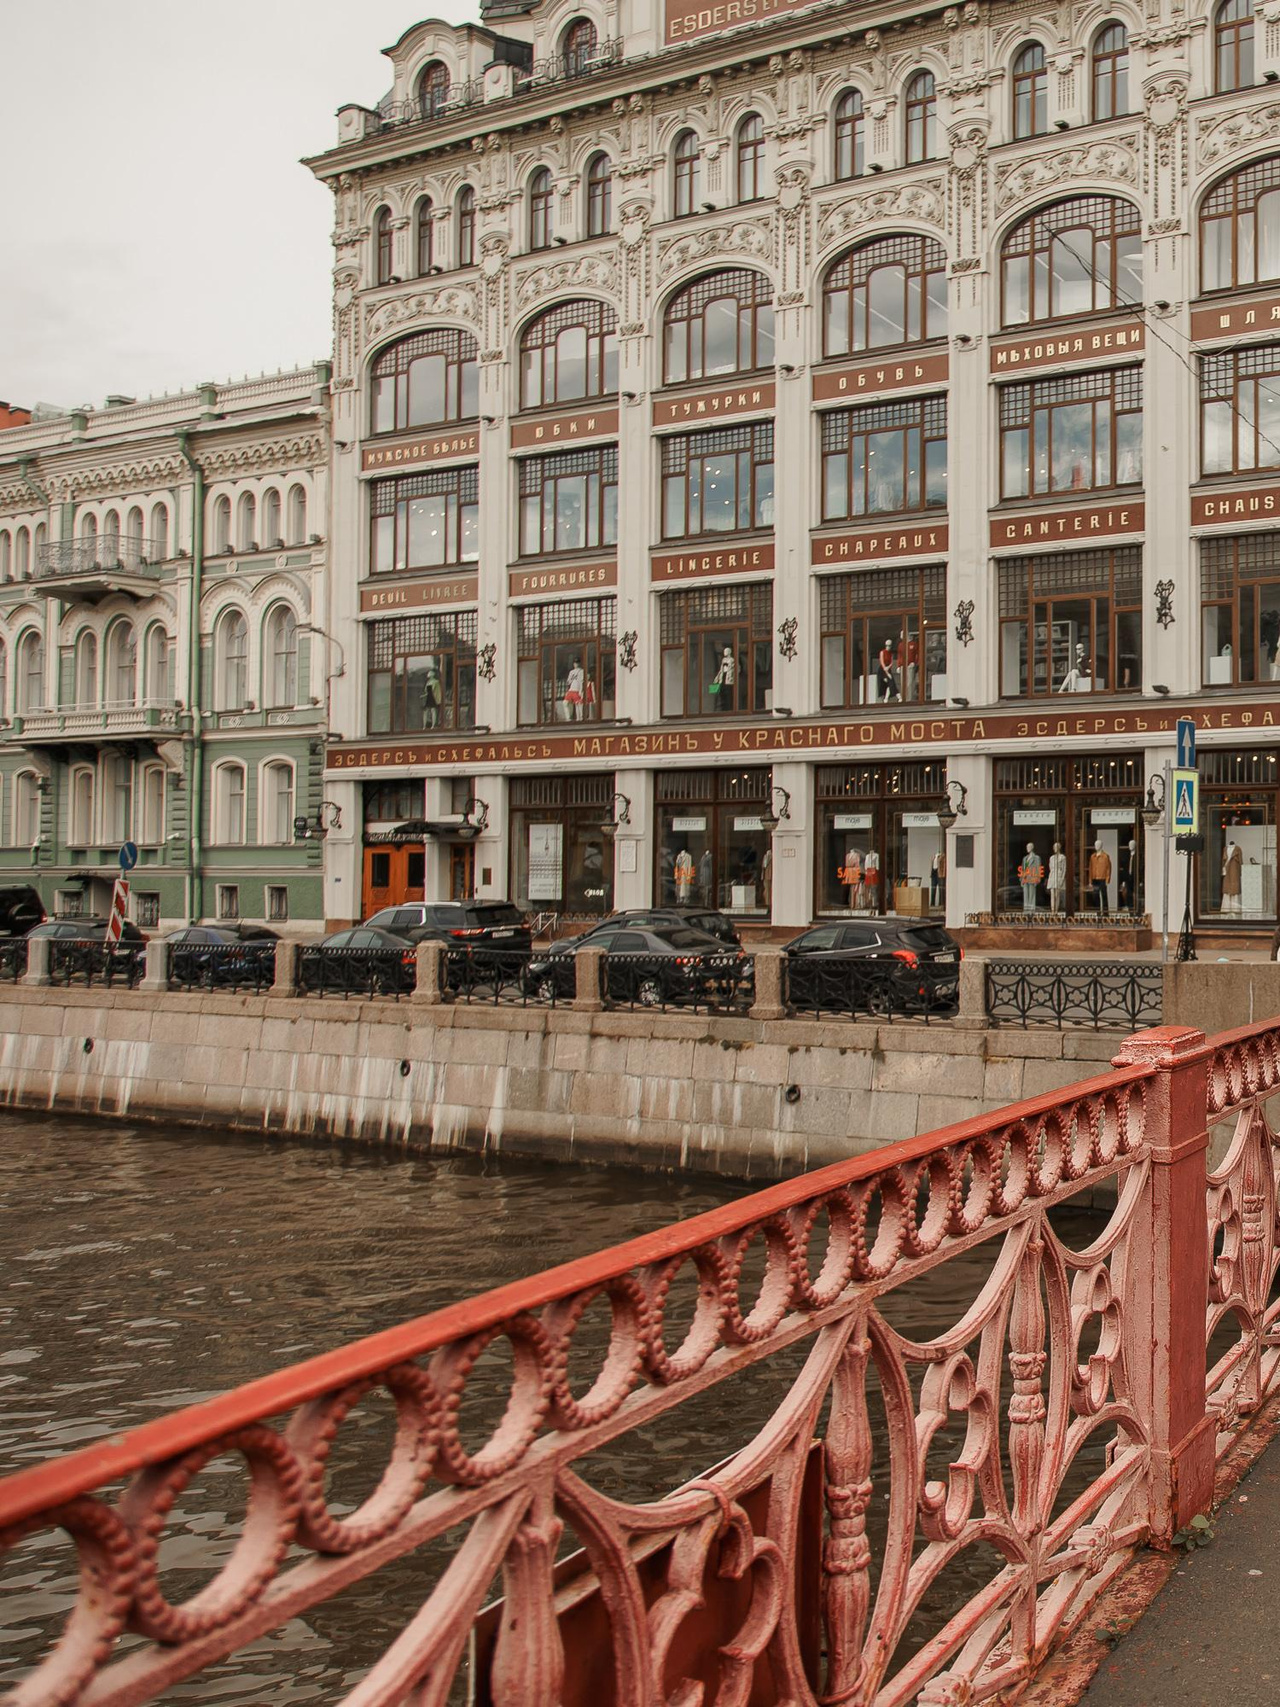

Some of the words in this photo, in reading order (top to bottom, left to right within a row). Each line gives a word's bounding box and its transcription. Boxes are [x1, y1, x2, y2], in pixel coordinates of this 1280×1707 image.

[670, 0, 757, 37] ESDERS
[1092, 329, 1140, 349] ВЕЩИ
[839, 365, 923, 390] ОБУВЬ
[670, 391, 761, 417] ТУЖУРКИ
[367, 444, 428, 465] МУЖСКОЕ
[825, 532, 936, 557] CHAPEAUX
[522, 568, 606, 590] FOURRURES
[371, 590, 408, 606] DEUIL
[573, 733, 699, 755] МАГАЗИНЪ
[713, 731, 724, 749] У
[739, 724, 875, 749] КРАСНАГО
[890, 719, 986, 742] МОСТА
[1017, 715, 1148, 737] ЭСДЕРСЪ
[1017, 865, 1045, 878] SALE
